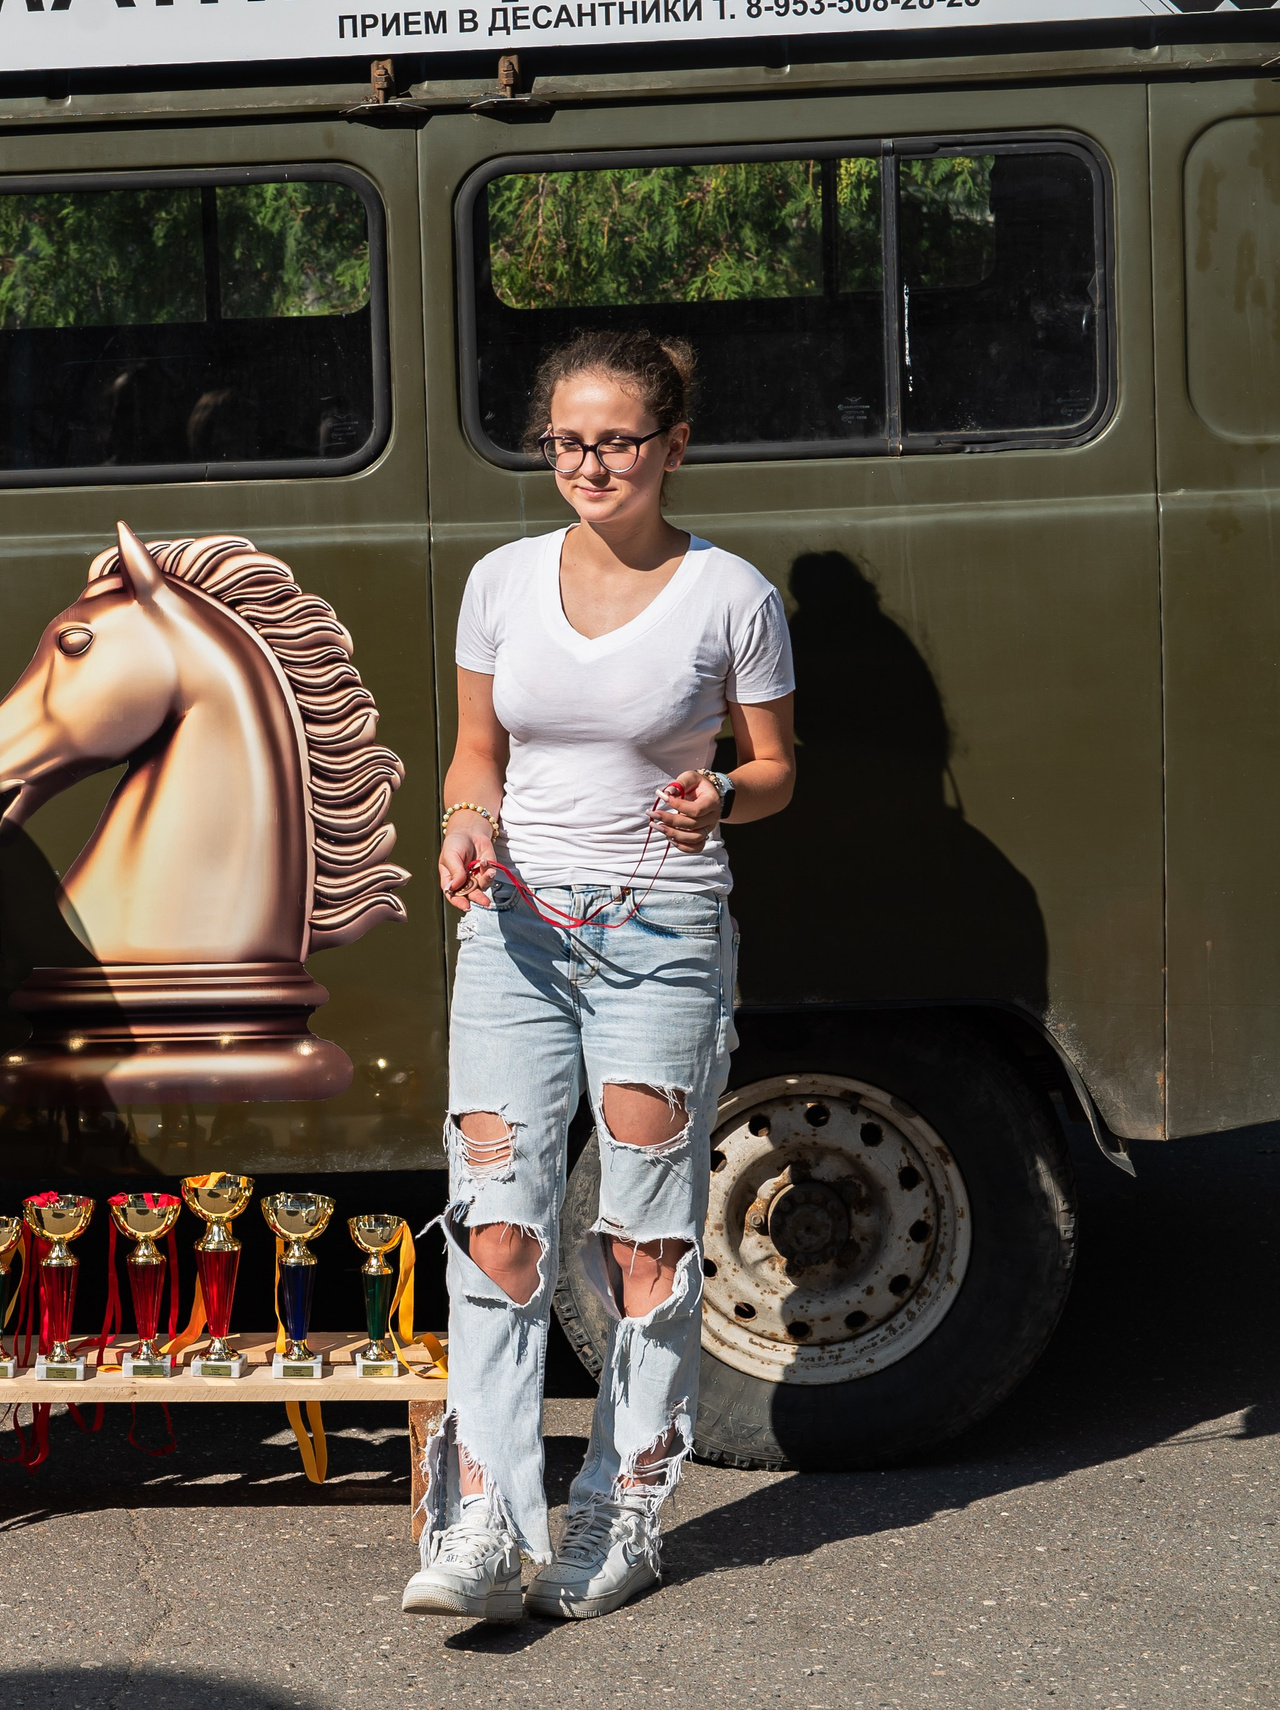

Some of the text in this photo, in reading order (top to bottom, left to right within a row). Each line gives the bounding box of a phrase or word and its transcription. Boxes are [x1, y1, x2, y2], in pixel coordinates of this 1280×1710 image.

[338, 11, 447, 38] ПРИЕМ
[459, 9, 479, 33] В
[488, 0, 702, 36] ДЕСАНТНИКИ
